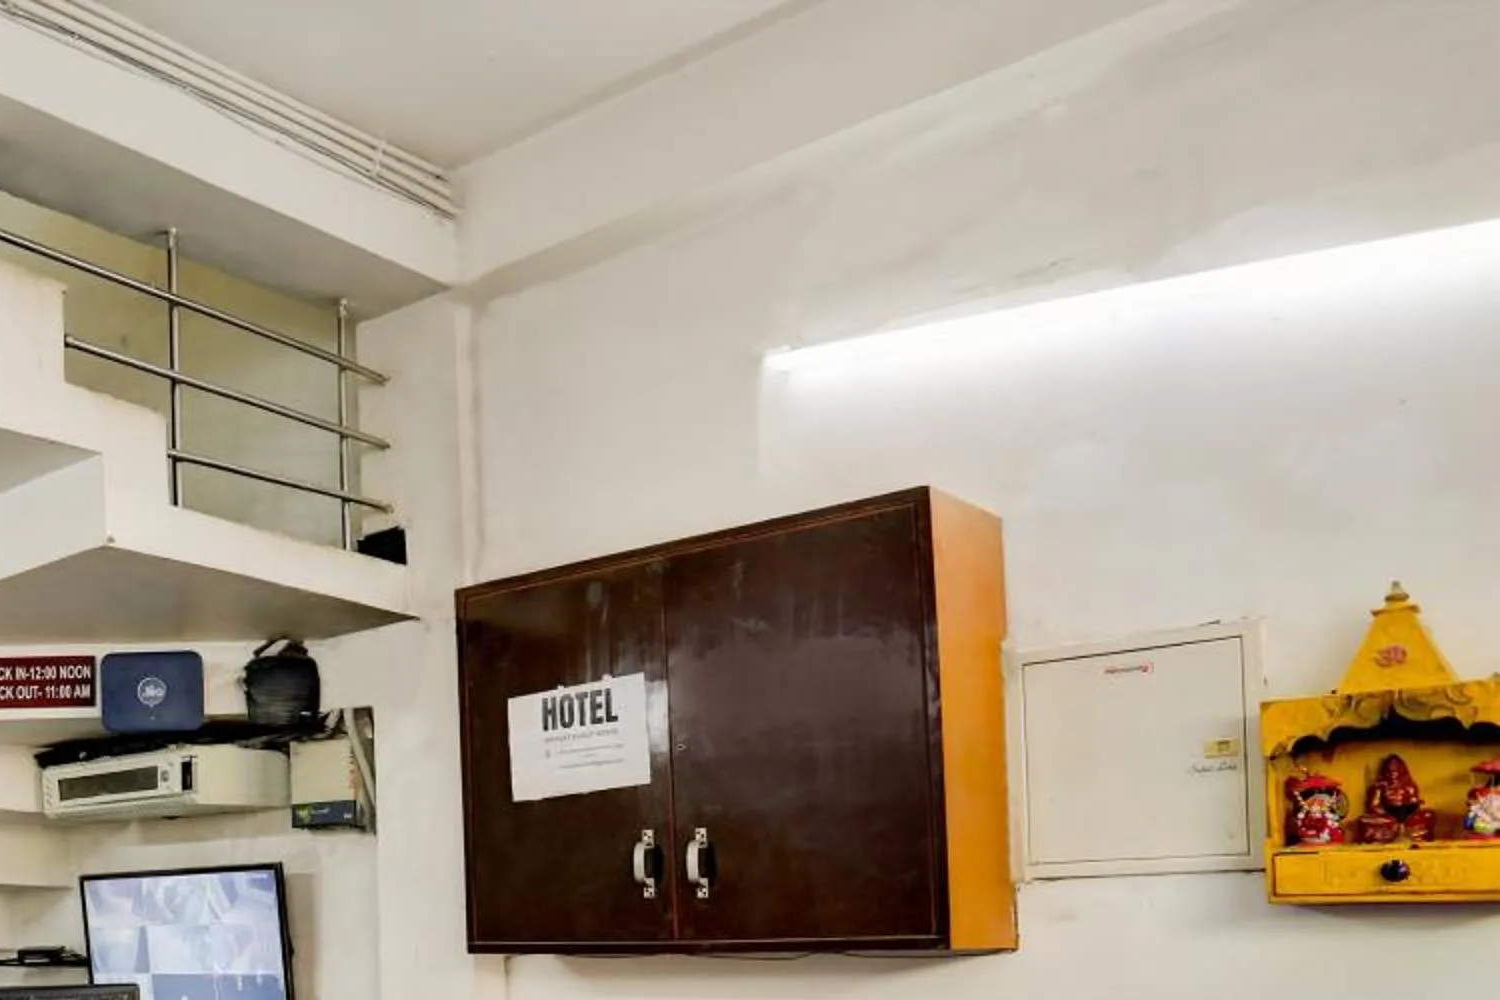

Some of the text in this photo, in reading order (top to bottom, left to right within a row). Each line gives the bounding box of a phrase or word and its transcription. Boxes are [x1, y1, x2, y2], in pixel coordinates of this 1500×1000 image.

[59, 665, 91, 679] NOON
[45, 685, 72, 699] 11:00
[73, 684, 91, 699] AM
[542, 688, 619, 732] HOTEL
